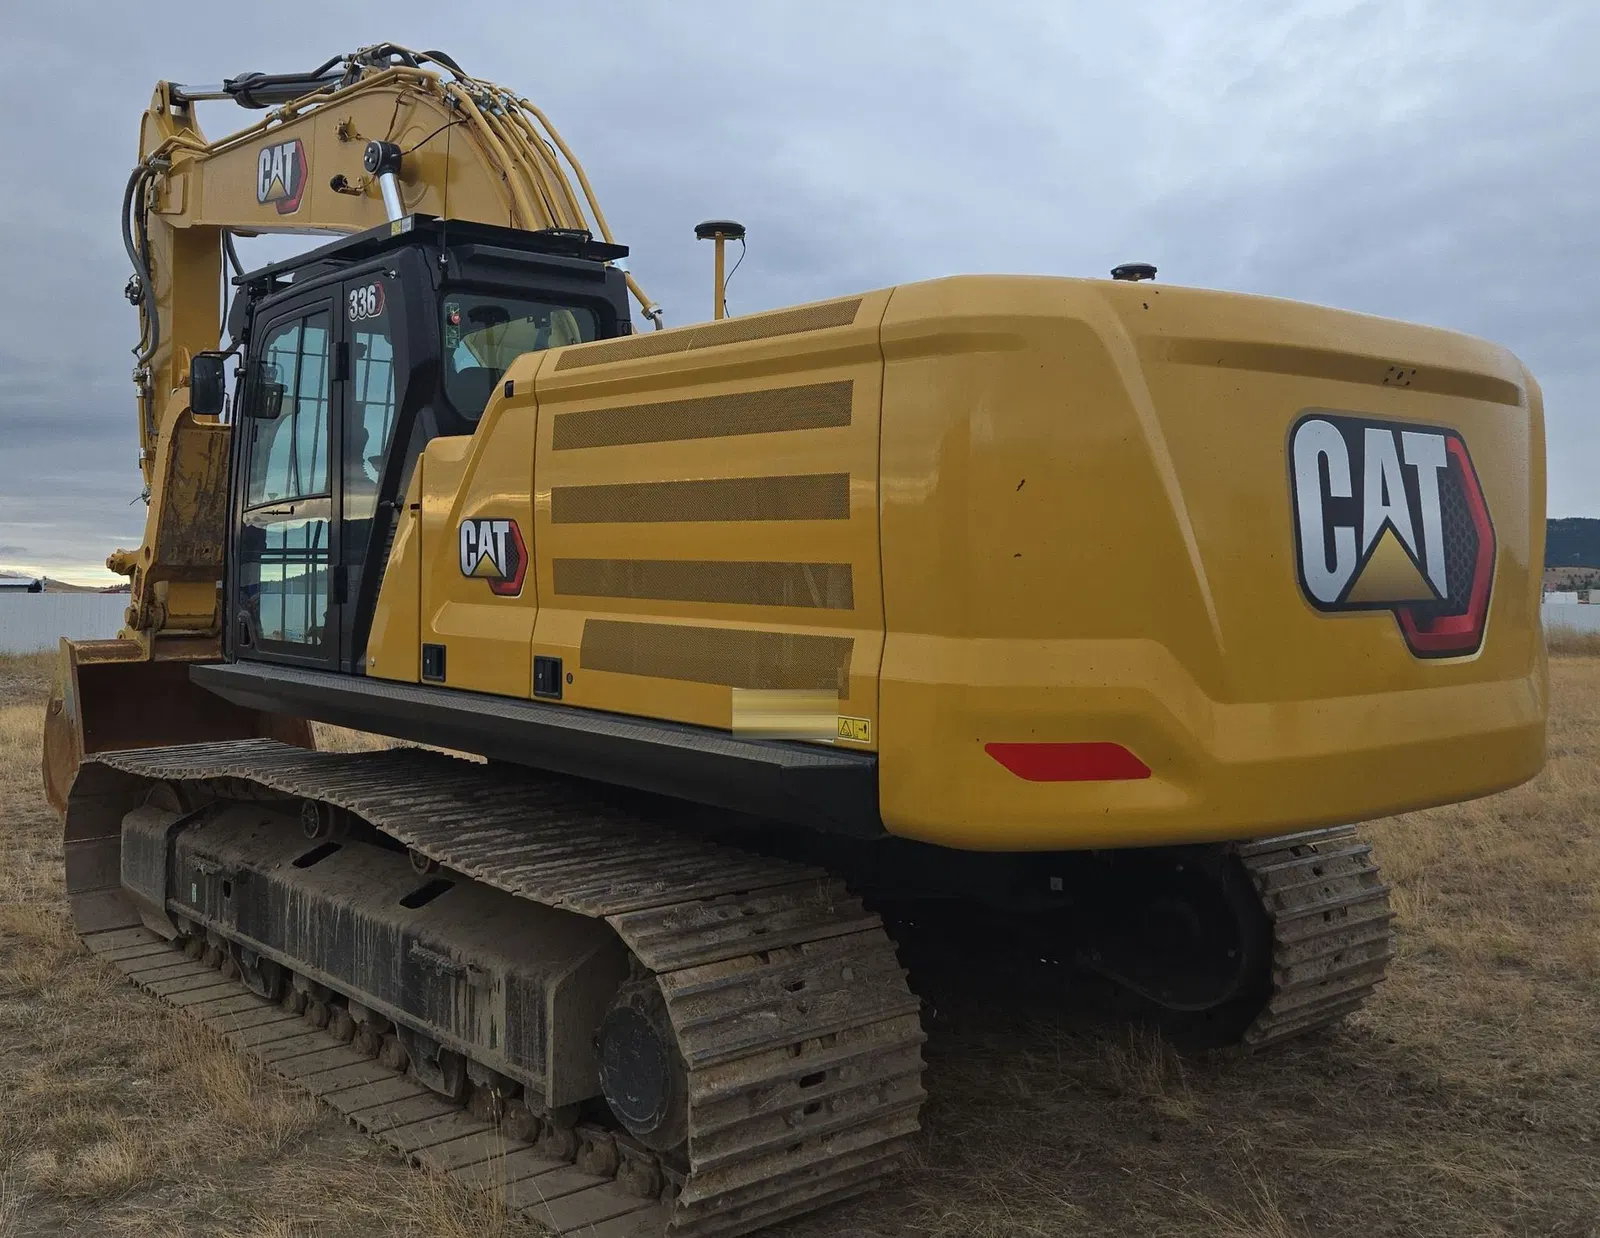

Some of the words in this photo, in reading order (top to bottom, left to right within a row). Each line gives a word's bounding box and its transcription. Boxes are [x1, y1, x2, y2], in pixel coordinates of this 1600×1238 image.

[258, 142, 296, 202] CAT
[350, 284, 377, 319] 336
[1293, 419, 1448, 603] CAT
[460, 520, 509, 578] CAT
